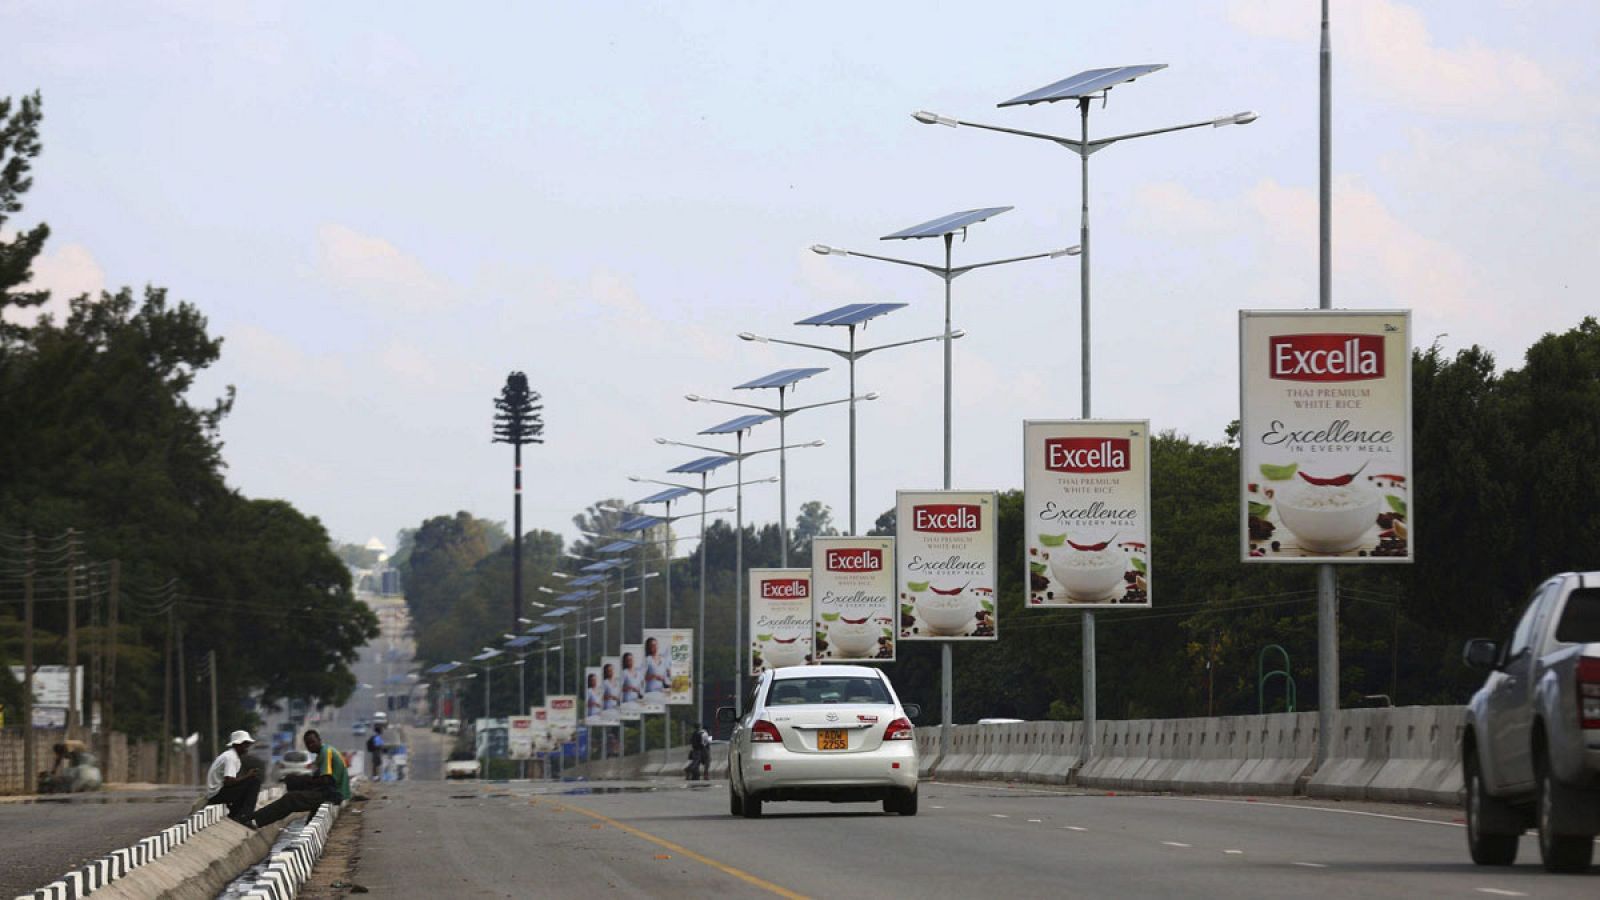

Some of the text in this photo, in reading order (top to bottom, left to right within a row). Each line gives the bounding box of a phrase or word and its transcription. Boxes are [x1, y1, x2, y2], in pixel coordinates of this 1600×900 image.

[1275, 338, 1377, 375] Excella
[1287, 388, 1371, 398] THAI PREMIUM
[1295, 400, 1362, 409] WHITE RICE
[1261, 419, 1394, 448] Excellence
[1050, 440, 1125, 468] Excella
[1311, 445, 1351, 453] EVERY
[1359, 445, 1392, 453] MEAL
[916, 507, 977, 529] Excella
[1039, 501, 1138, 521] Excellence
[828, 550, 879, 569] Excella
[907, 555, 986, 571] Excellence
[763, 580, 806, 597] Excella
[823, 739, 846, 749] 2755
